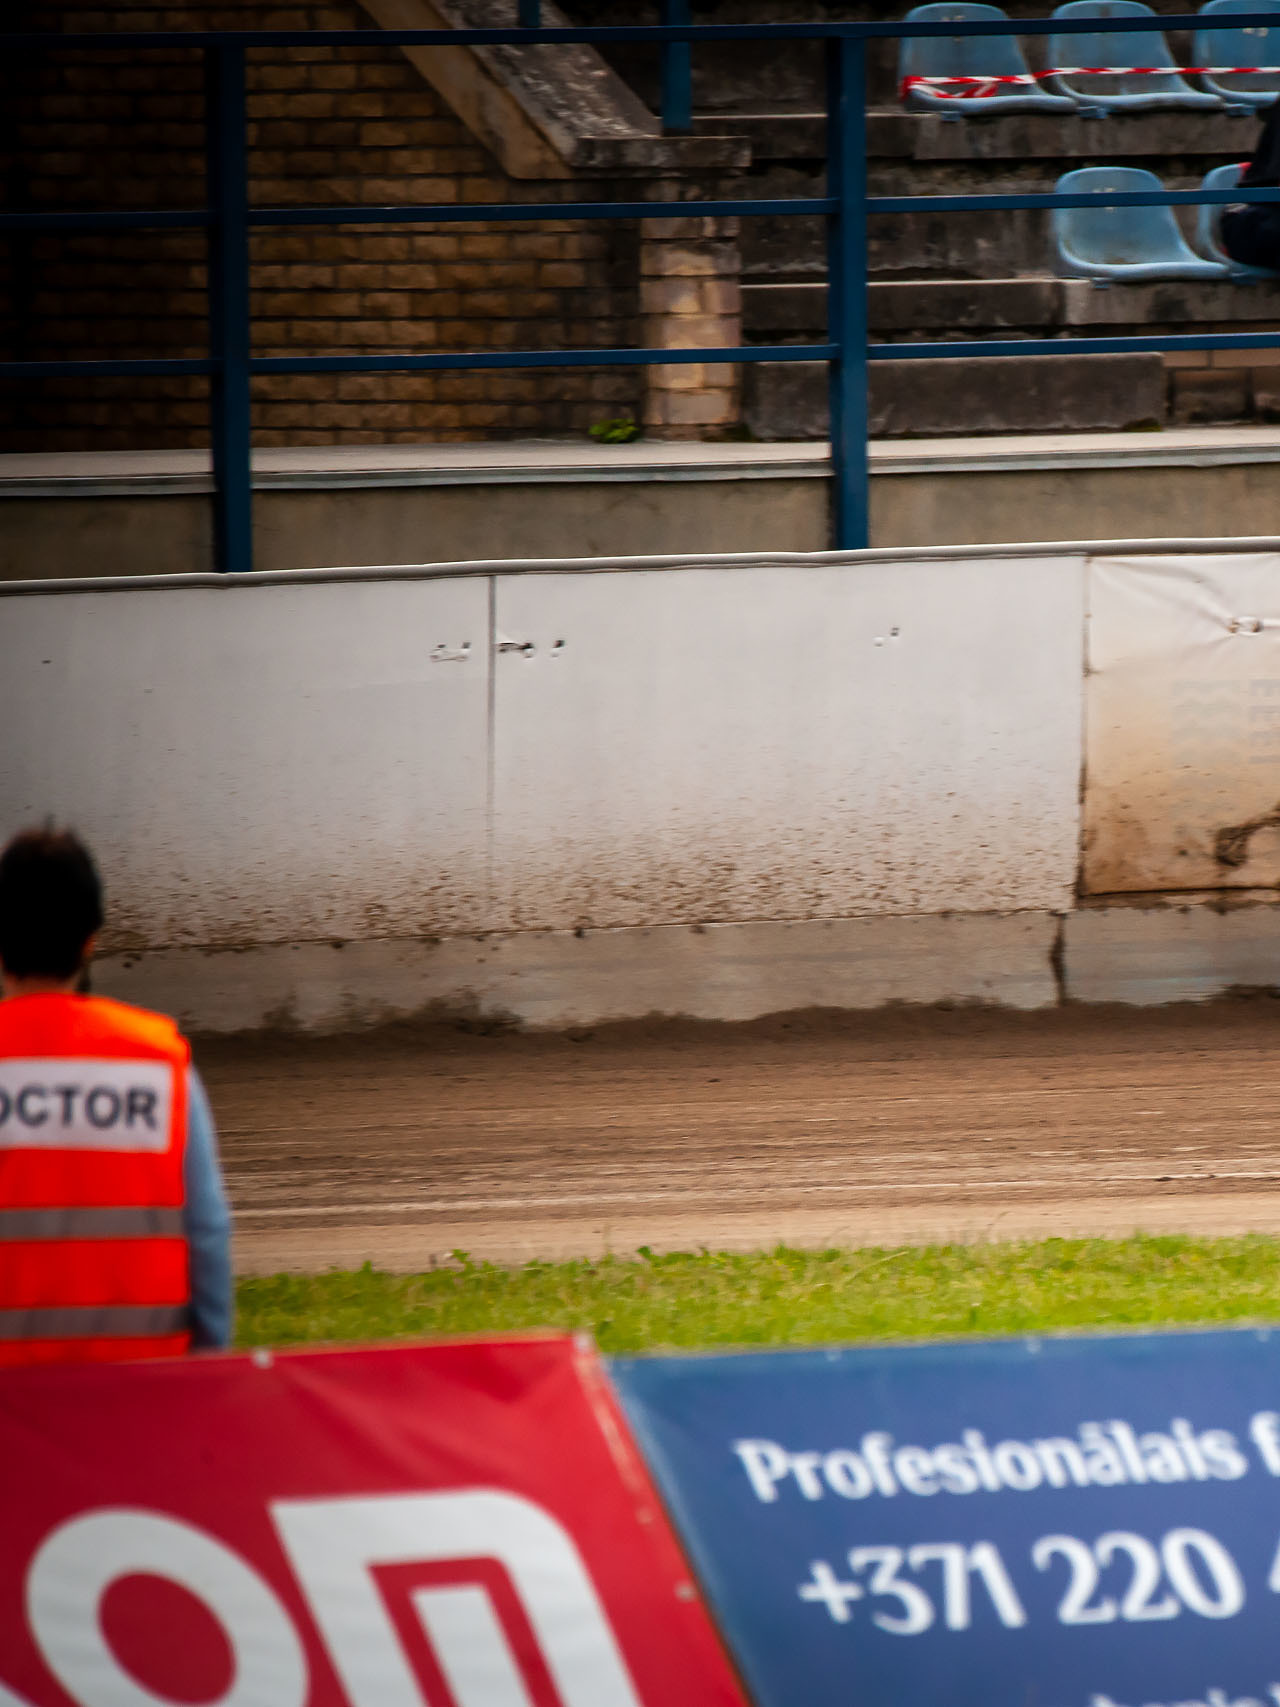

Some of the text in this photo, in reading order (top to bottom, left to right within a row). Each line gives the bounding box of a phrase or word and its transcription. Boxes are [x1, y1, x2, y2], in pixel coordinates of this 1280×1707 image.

[732, 1419, 1248, 1503] Profesionālais
[799, 1541, 1028, 1636] +371
[1032, 1527, 1245, 1626] 220
